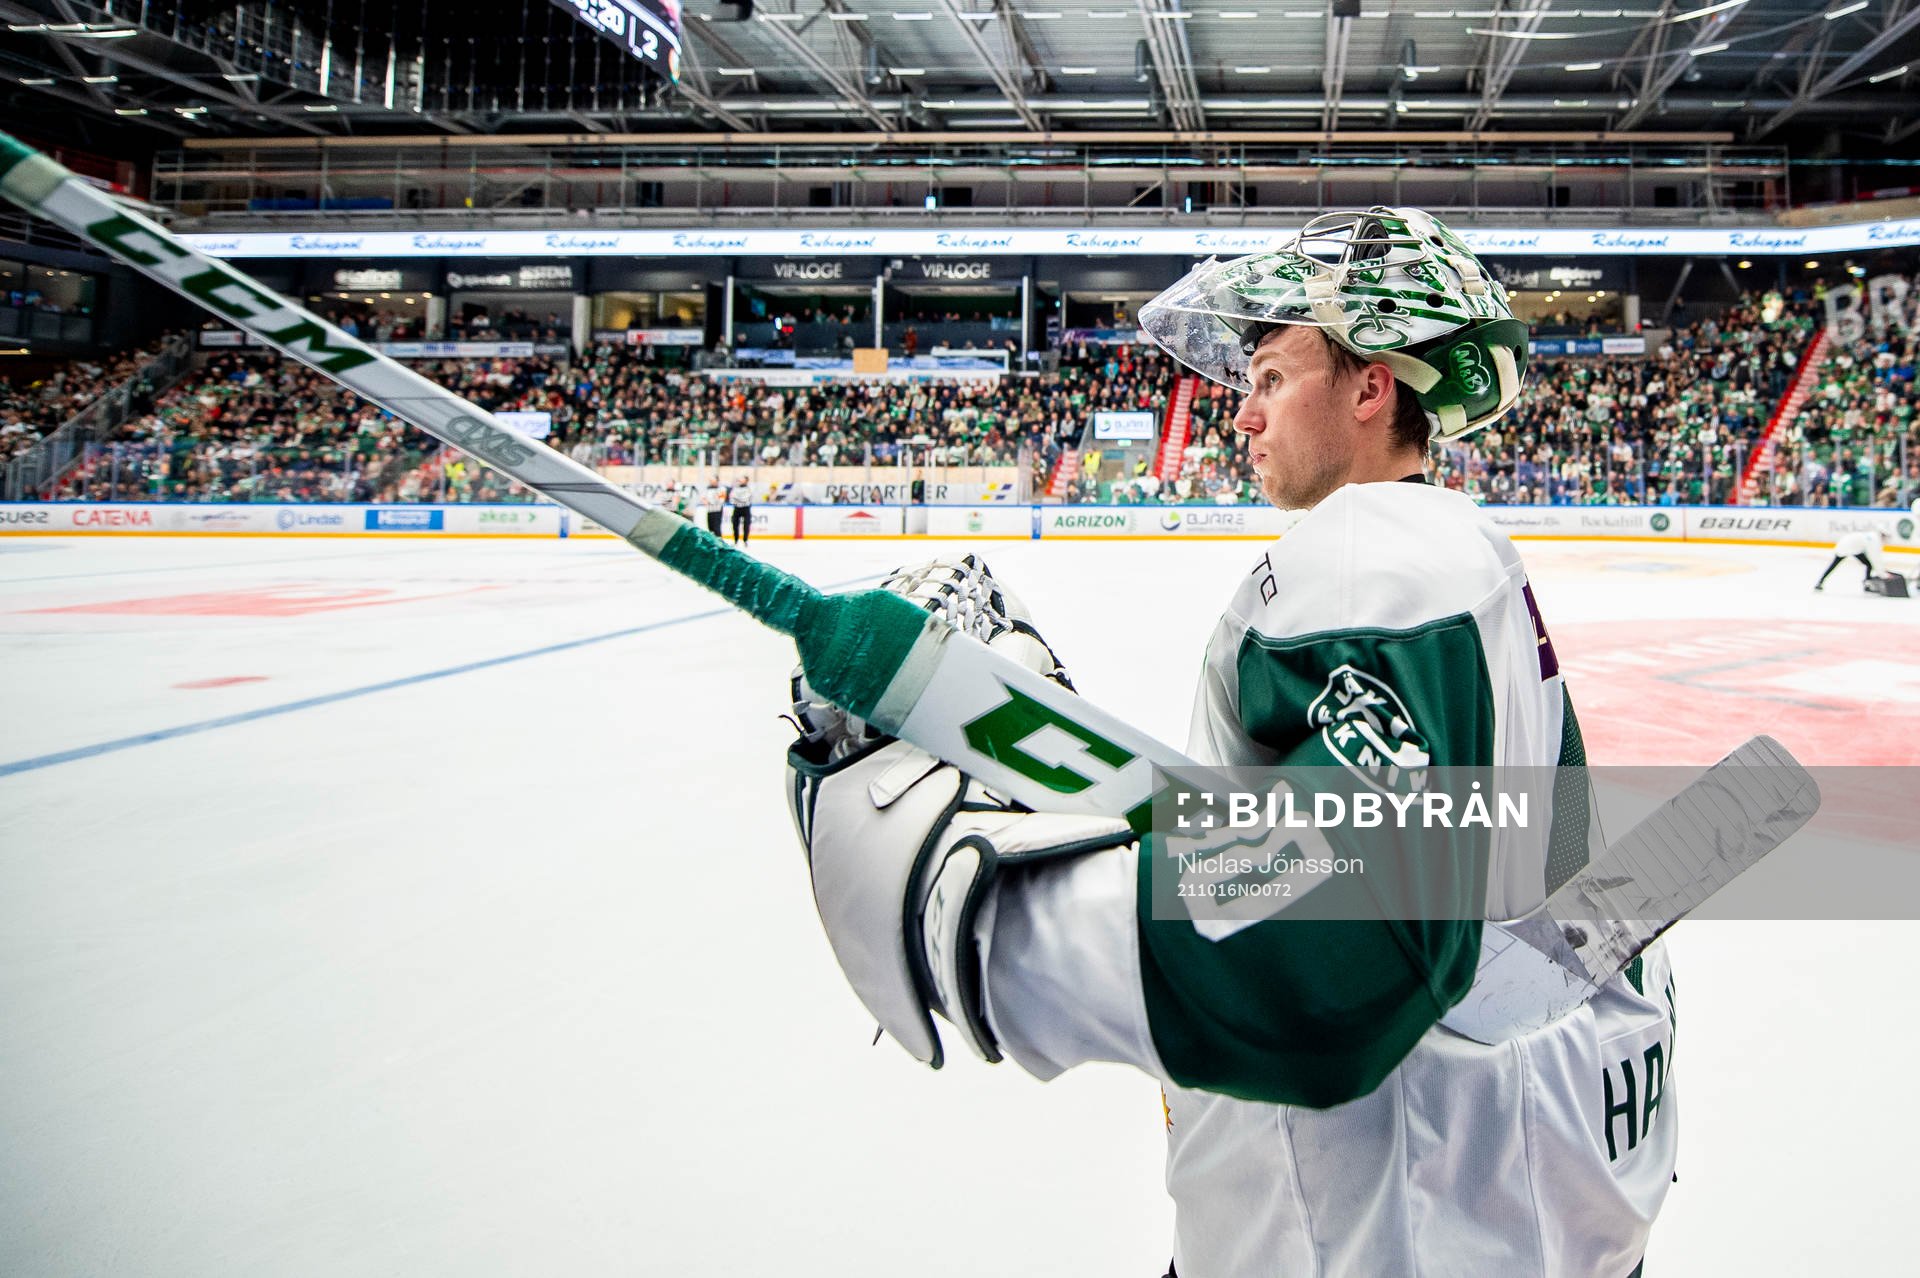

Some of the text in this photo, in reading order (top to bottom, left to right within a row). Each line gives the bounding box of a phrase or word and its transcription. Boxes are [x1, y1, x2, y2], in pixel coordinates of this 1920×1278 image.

[546, 234, 620, 250] Rubinpool
[673, 233, 748, 249] Rubinpool
[800, 233, 876, 249] Rubinpool
[936, 232, 1013, 248] Rubinpool
[1066, 233, 1143, 249] Rubinpool
[1592, 233, 1669, 251] Rubinpool
[1728, 233, 1807, 250] Rubinpool
[774, 263, 843, 280] VIP-LOGE
[921, 263, 990, 280] VIP-LOGE
[88, 212, 378, 373] CCM
[825, 484, 948, 500] RESPARTER
[72, 509, 152, 526] CATENA
[1054, 514, 1126, 528] AGRIZON
[1699, 517, 1793, 531] BAUER
